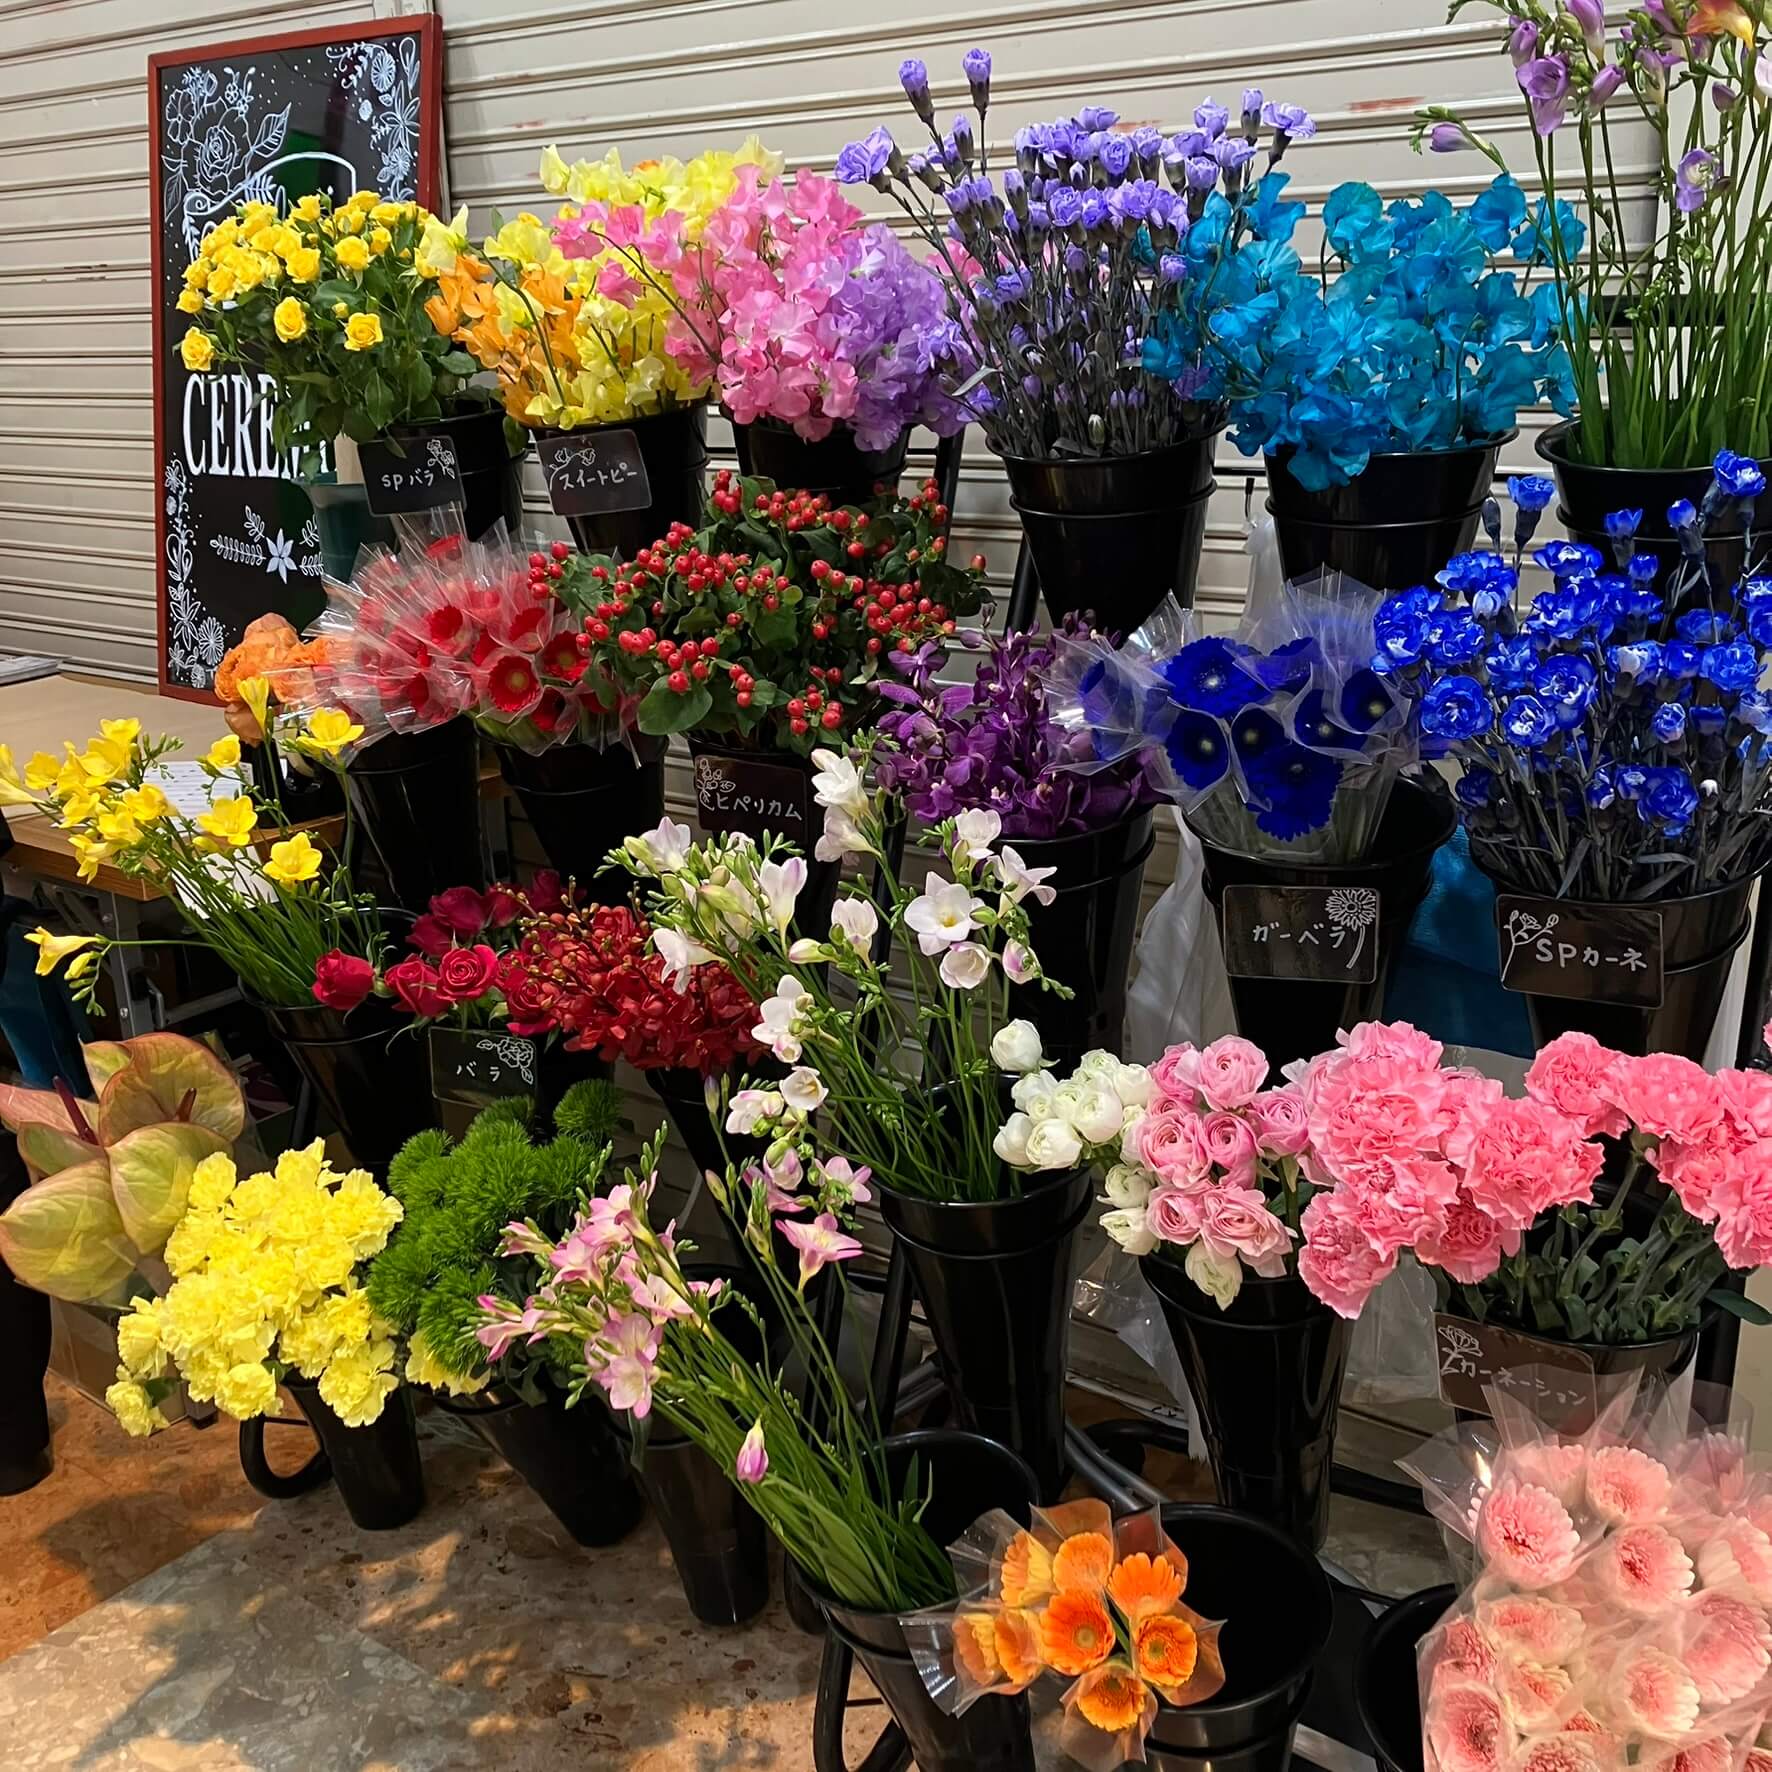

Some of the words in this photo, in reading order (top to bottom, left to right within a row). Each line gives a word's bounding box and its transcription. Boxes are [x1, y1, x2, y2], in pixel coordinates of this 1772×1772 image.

[559, 462, 637, 490] スイートピー
[716, 792, 802, 820] ヒペリカム
[1252, 921, 1346, 948] ガーベラ
[456, 1060, 500, 1082] バラ
[1460, 1359, 1587, 1405] カーネーション
